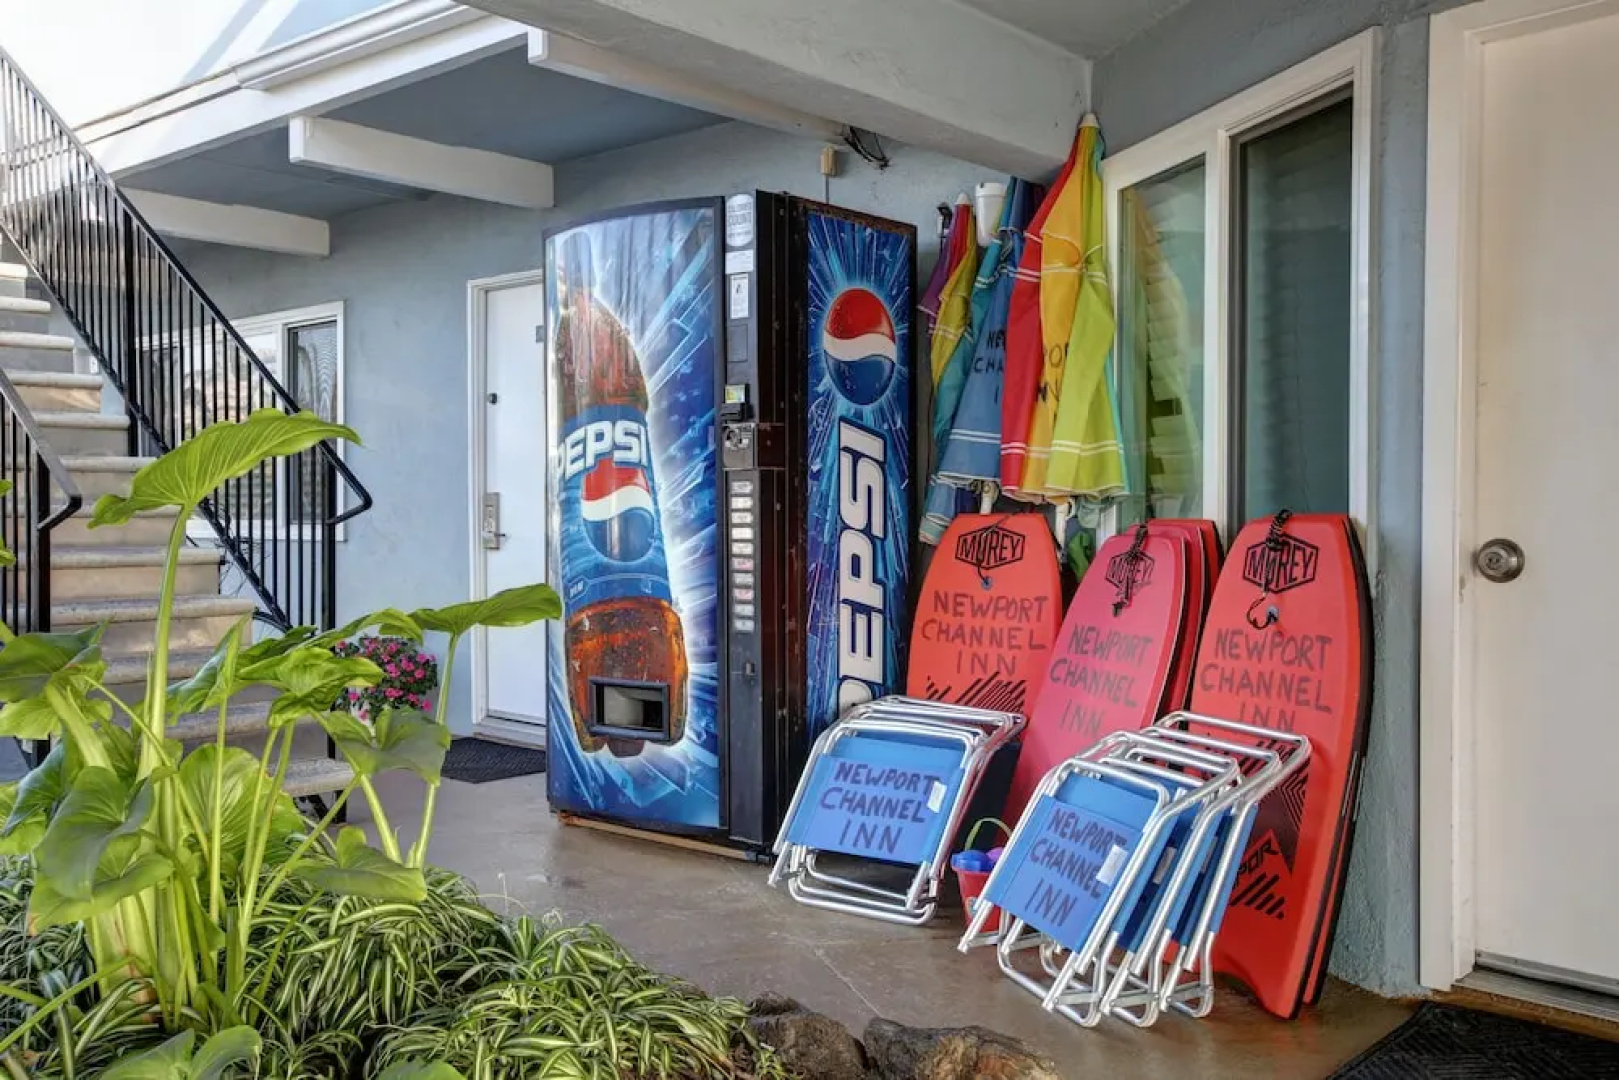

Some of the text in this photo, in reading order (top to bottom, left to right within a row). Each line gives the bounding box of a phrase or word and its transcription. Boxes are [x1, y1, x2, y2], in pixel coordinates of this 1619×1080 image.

[960, 531, 1020, 566] MOREY
[933, 590, 1049, 622] NEWPORT
[922, 619, 1047, 650] CHANNEL
[1069, 625, 1153, 667] NEWPORT
[1215, 628, 1333, 670] NEWPORT
[956, 652, 1016, 675] INN
[1050, 659, 1138, 707] CHANNEL
[1202, 663, 1333, 714] CHANNEL
[1061, 699, 1105, 733] INN
[1239, 702, 1296, 733] INN
[834, 762, 941, 796] NEWPORT
[820, 787, 925, 823] CHANNEL
[839, 820, 902, 854] INN
[1024, 877, 1079, 927] INN
